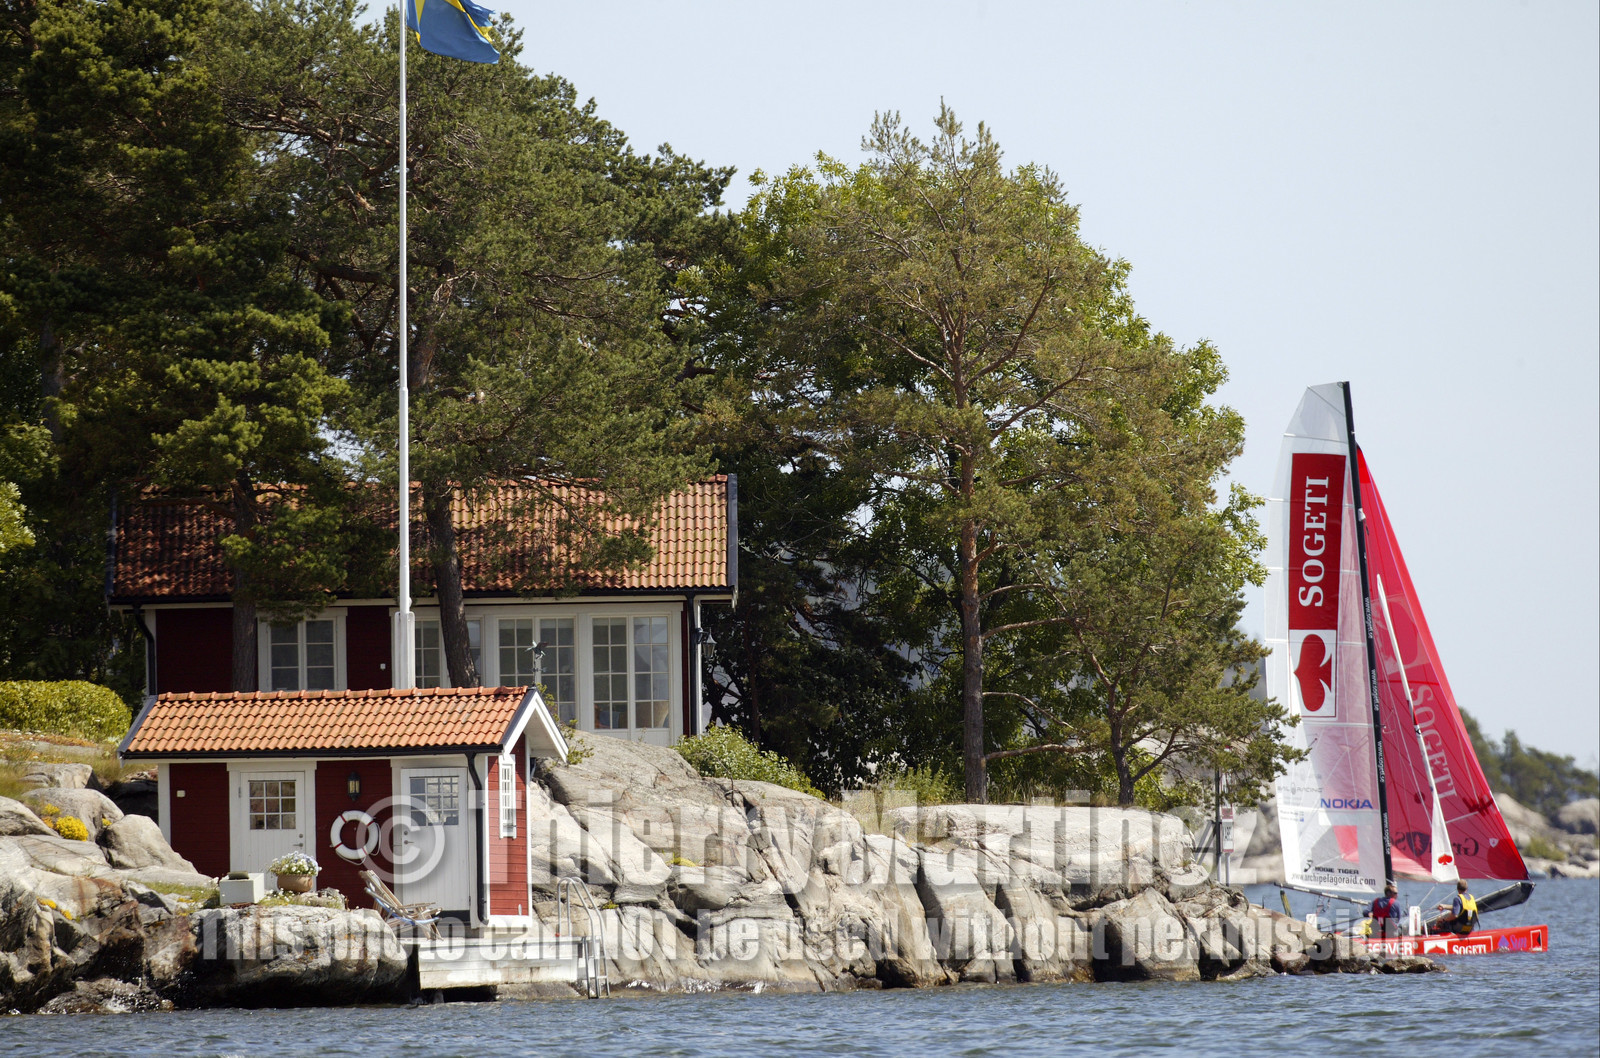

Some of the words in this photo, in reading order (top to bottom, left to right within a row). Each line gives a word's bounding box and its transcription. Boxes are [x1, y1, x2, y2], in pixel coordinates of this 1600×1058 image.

[1298, 476, 1329, 607] SOGETI
[1409, 684, 1457, 800] SOGETI
[1320, 798, 1374, 810] NOKIA
